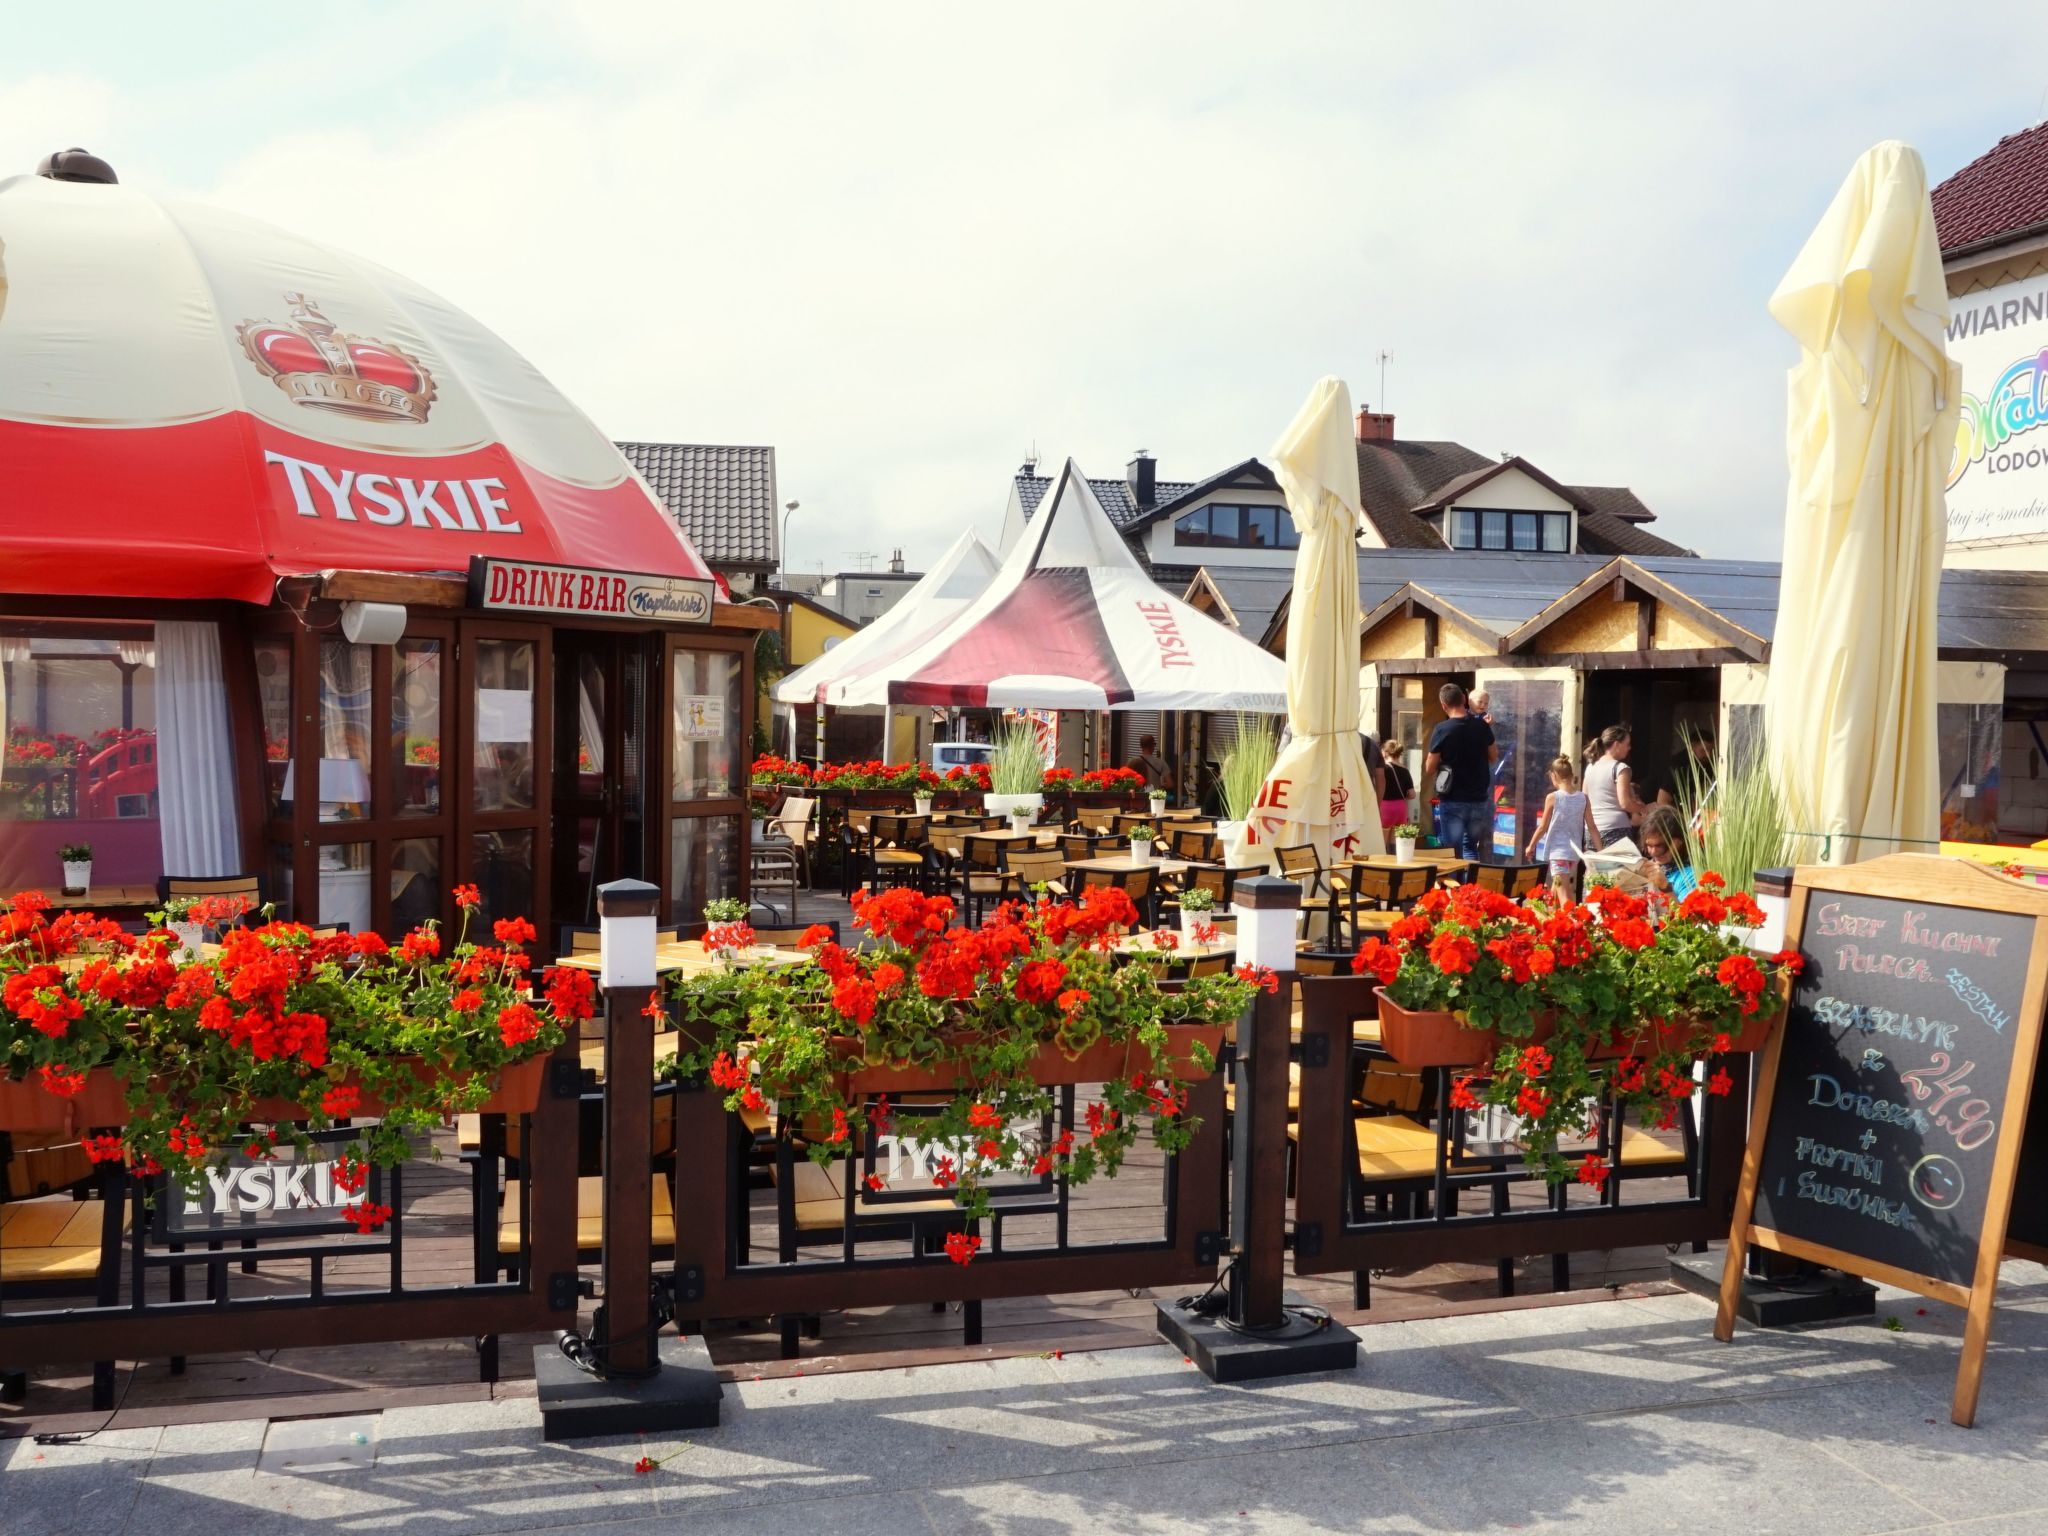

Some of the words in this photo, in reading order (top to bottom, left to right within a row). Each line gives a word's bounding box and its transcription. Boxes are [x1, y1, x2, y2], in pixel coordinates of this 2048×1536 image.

[264, 450, 523, 534] TYSKIE
[489, 566, 576, 608] DRINK
[577, 575, 627, 613] BAR
[1136, 600, 1195, 669] TYSKIE
[877, 1123, 1043, 1182] TYS
